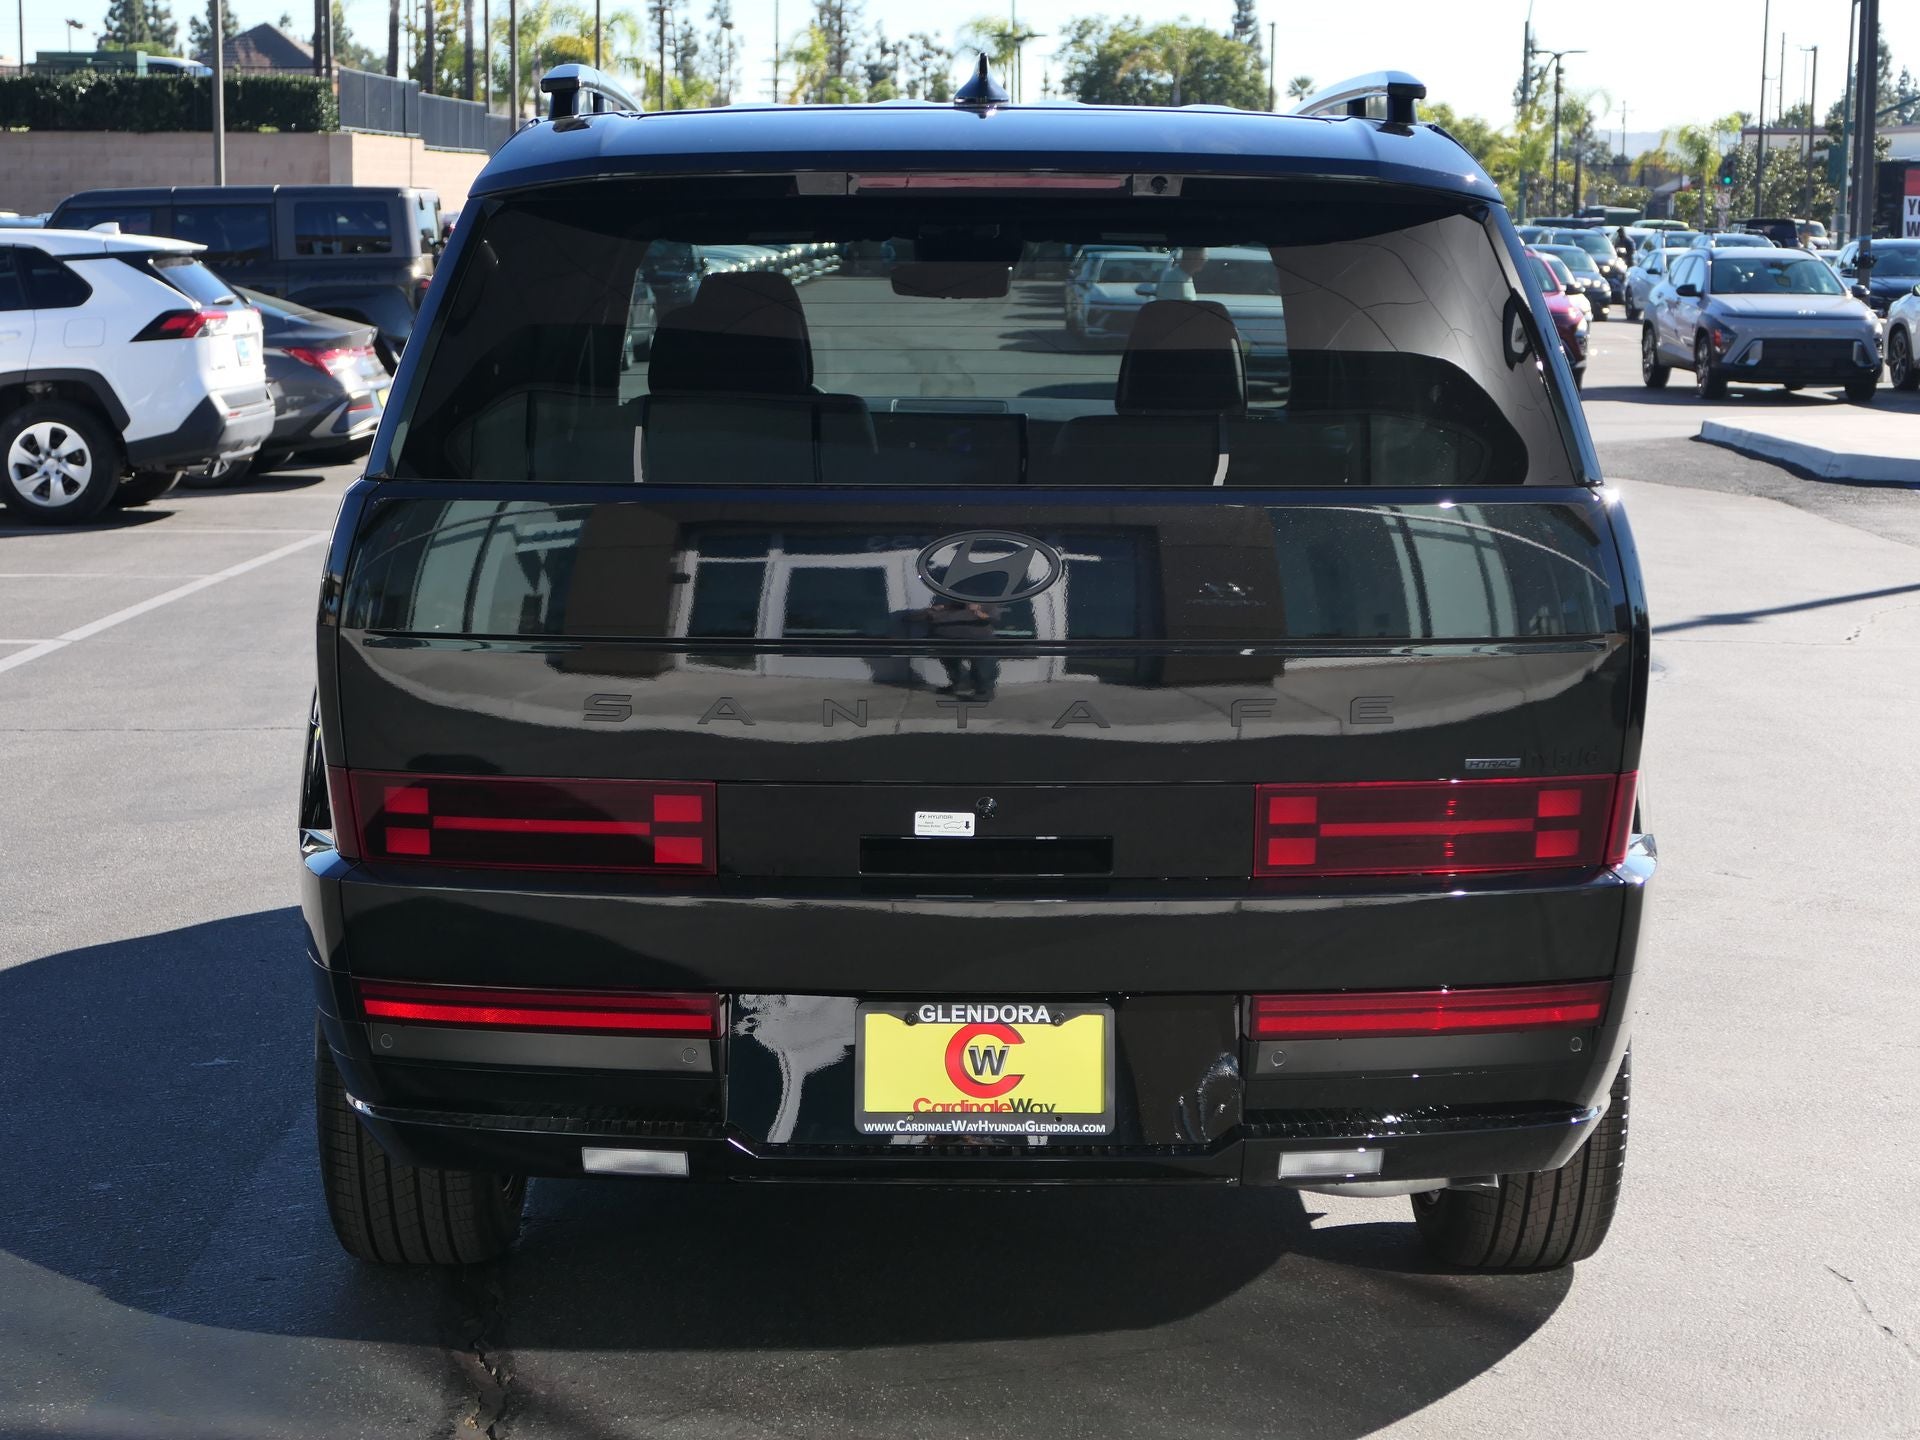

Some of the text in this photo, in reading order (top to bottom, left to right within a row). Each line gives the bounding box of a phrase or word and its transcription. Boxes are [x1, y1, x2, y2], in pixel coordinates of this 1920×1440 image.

[583, 693, 1395, 729] SANTA FE
[1467, 759, 1519, 769] HTRAC
[918, 1004, 1052, 1024] GLENDORA
